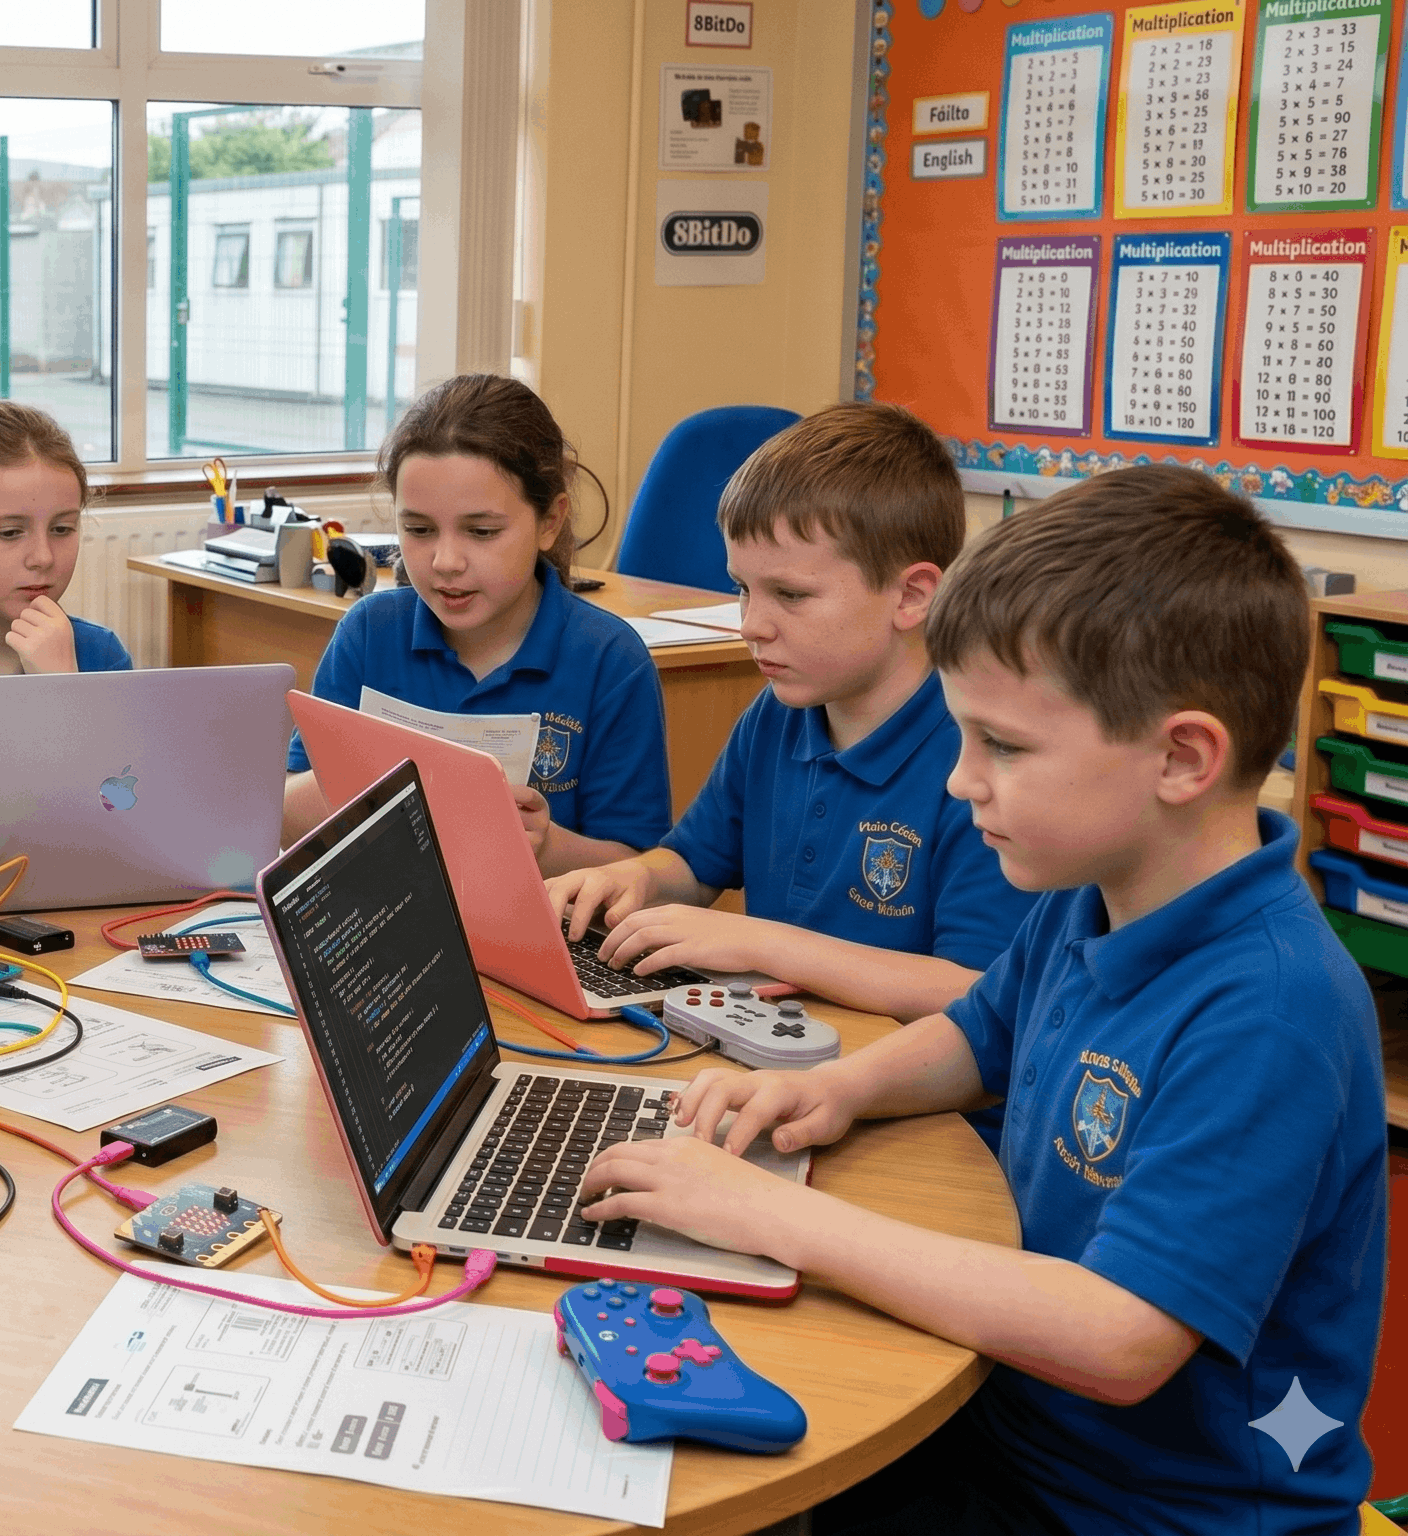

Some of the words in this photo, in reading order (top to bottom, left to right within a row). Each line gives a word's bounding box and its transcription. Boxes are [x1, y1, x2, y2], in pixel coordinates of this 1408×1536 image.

[694, 15, 745, 33] 8BitDo
[1286, 30, 1292, 41] 2
[1313, 27, 1320, 38] 3
[1342, 22, 1356, 36] 33
[1011, 25, 1104, 47] Multiplication
[1150, 46, 1156, 56] 2
[1175, 43, 1180, 53] 2
[1200, 39, 1212, 50] 18
[1285, 47, 1292, 58] 2
[1312, 44, 1319, 56] 3
[1340, 41, 1354, 53] 15
[1283, 65, 1290, 76] 3
[1311, 62, 1318, 73] 3
[1337, 58, 1353, 71] 24
[1148, 78, 1154, 88] 3
[1172, 76, 1178, 86] 3
[1196, 72, 1210, 84] 23
[1282, 82, 1288, 93] 3
[1309, 79, 1316, 90] 4
[1338, 77, 1344, 88] 7
[1280, 99, 1287, 110] 3
[1308, 97, 1315, 108] 5
[1336, 94, 1343, 106] 5
[1146, 110, 1151, 121] 3
[1170, 108, 1176, 119] 5
[1194, 106, 1208, 117] 25
[1280, 116, 1286, 128] 5
[1307, 114, 1314, 126] 5
[1334, 111, 1350, 124] 90
[1144, 126, 1150, 137] 5
[1168, 124, 1175, 136] 6
[1193, 122, 1207, 134] 23
[1278, 133, 1286, 145] 5
[1306, 131, 1313, 143] 6
[1332, 129, 1348, 141] 27
[922, 147, 973, 171] English
[1277, 150, 1284, 162] 5
[1305, 149, 1312, 160] 5
[1332, 147, 1347, 159] 76
[1142, 175, 1148, 185] 5
[1166, 174, 1173, 184] 9
[1190, 172, 1204, 183] 25
[1276, 168, 1283, 179] 5
[1304, 166, 1311, 178] 9
[1330, 164, 1346, 176] 38
[1142, 191, 1148, 201] 5
[1162, 190, 1174, 200] 10
[1190, 188, 1204, 199] 30
[1276, 184, 1282, 196] 5
[1299, 184, 1312, 194] 10
[1330, 182, 1346, 194] 20
[673, 220, 751, 247] 8BitDo
[1002, 243, 1093, 264] Multiplication
[1119, 241, 1221, 262] Multiplication
[1249, 238, 1366, 260] Multiplication
[1268, 288, 1276, 299] 8
[1294, 288, 1302, 299] 5
[1322, 287, 1338, 299] 30
[1268, 305, 1274, 315] 7
[1294, 305, 1300, 315] 7
[1320, 305, 1336, 316] 50
[1266, 322, 1272, 333] 9
[1292, 322, 1299, 333] 5
[1319, 322, 1335, 334] 50
[1264, 339, 1271, 350] 9
[1291, 339, 1298, 350] 8
[1318, 340, 1334, 352] 60
[1257, 389, 1269, 400] 10
[1314, 390, 1331, 404] 90
[1255, 422, 1266, 433] 13
[1283, 424, 1296, 435] 18
[1313, 426, 1334, 438] 120
